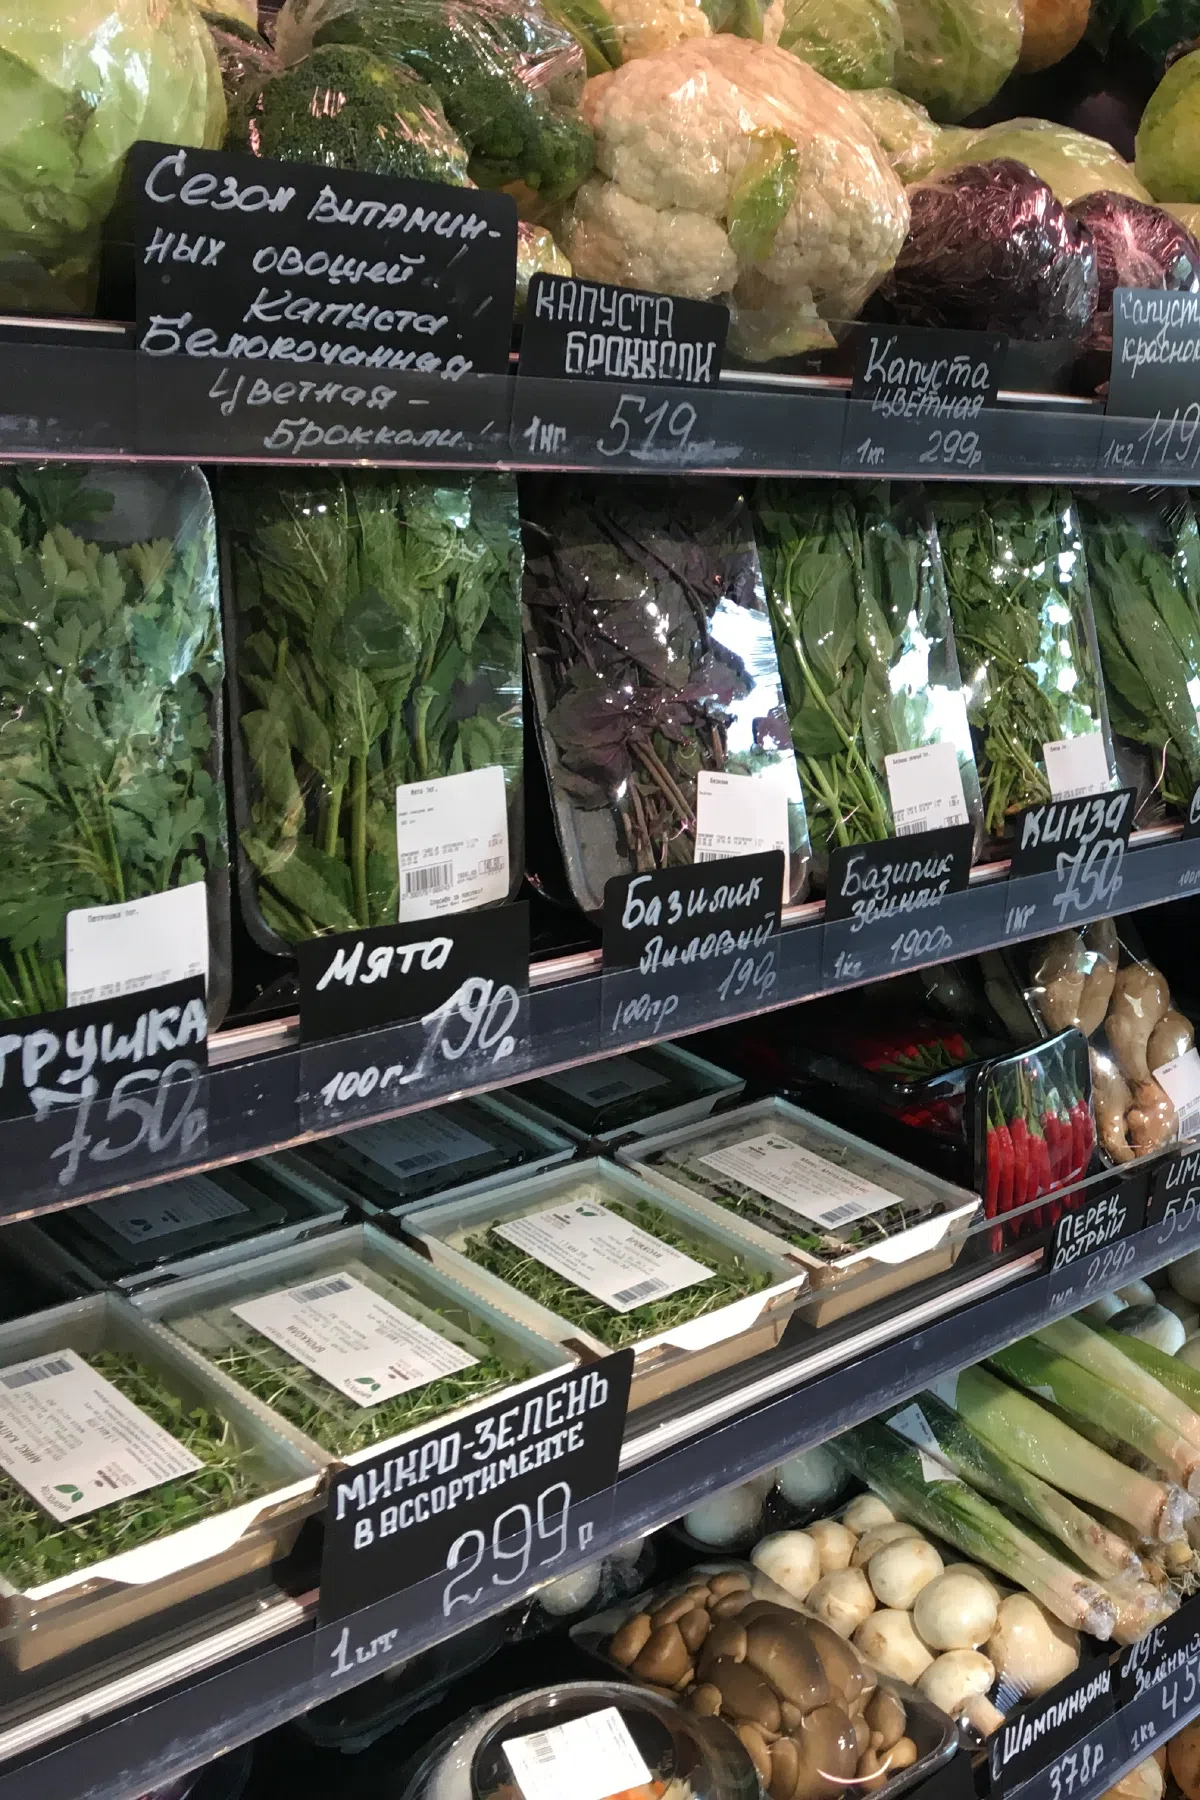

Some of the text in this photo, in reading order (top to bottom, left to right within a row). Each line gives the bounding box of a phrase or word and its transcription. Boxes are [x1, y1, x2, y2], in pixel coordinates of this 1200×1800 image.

[143, 226, 227, 267] ных
[535, 280, 674, 339] КАПУСТА
[565, 330, 717, 384] БРОККОЛИ
[864, 336, 991, 388] Капуста
[840, 854, 954, 897] Базилик
[621, 875, 763, 931] Базилик
[316, 940, 454, 991] Мята
[1052, 1206, 1128, 1272] ОСТРЫЙ
[1056, 1193, 1120, 1247] ПЕРЕЦ
[335, 1371, 609, 1521] МИКРО-ЗЕЛЕНЬ
[354, 1421, 585, 1550] В АССОРТИМЕНТЕ
[1122, 1625, 1167, 1679] Лук
